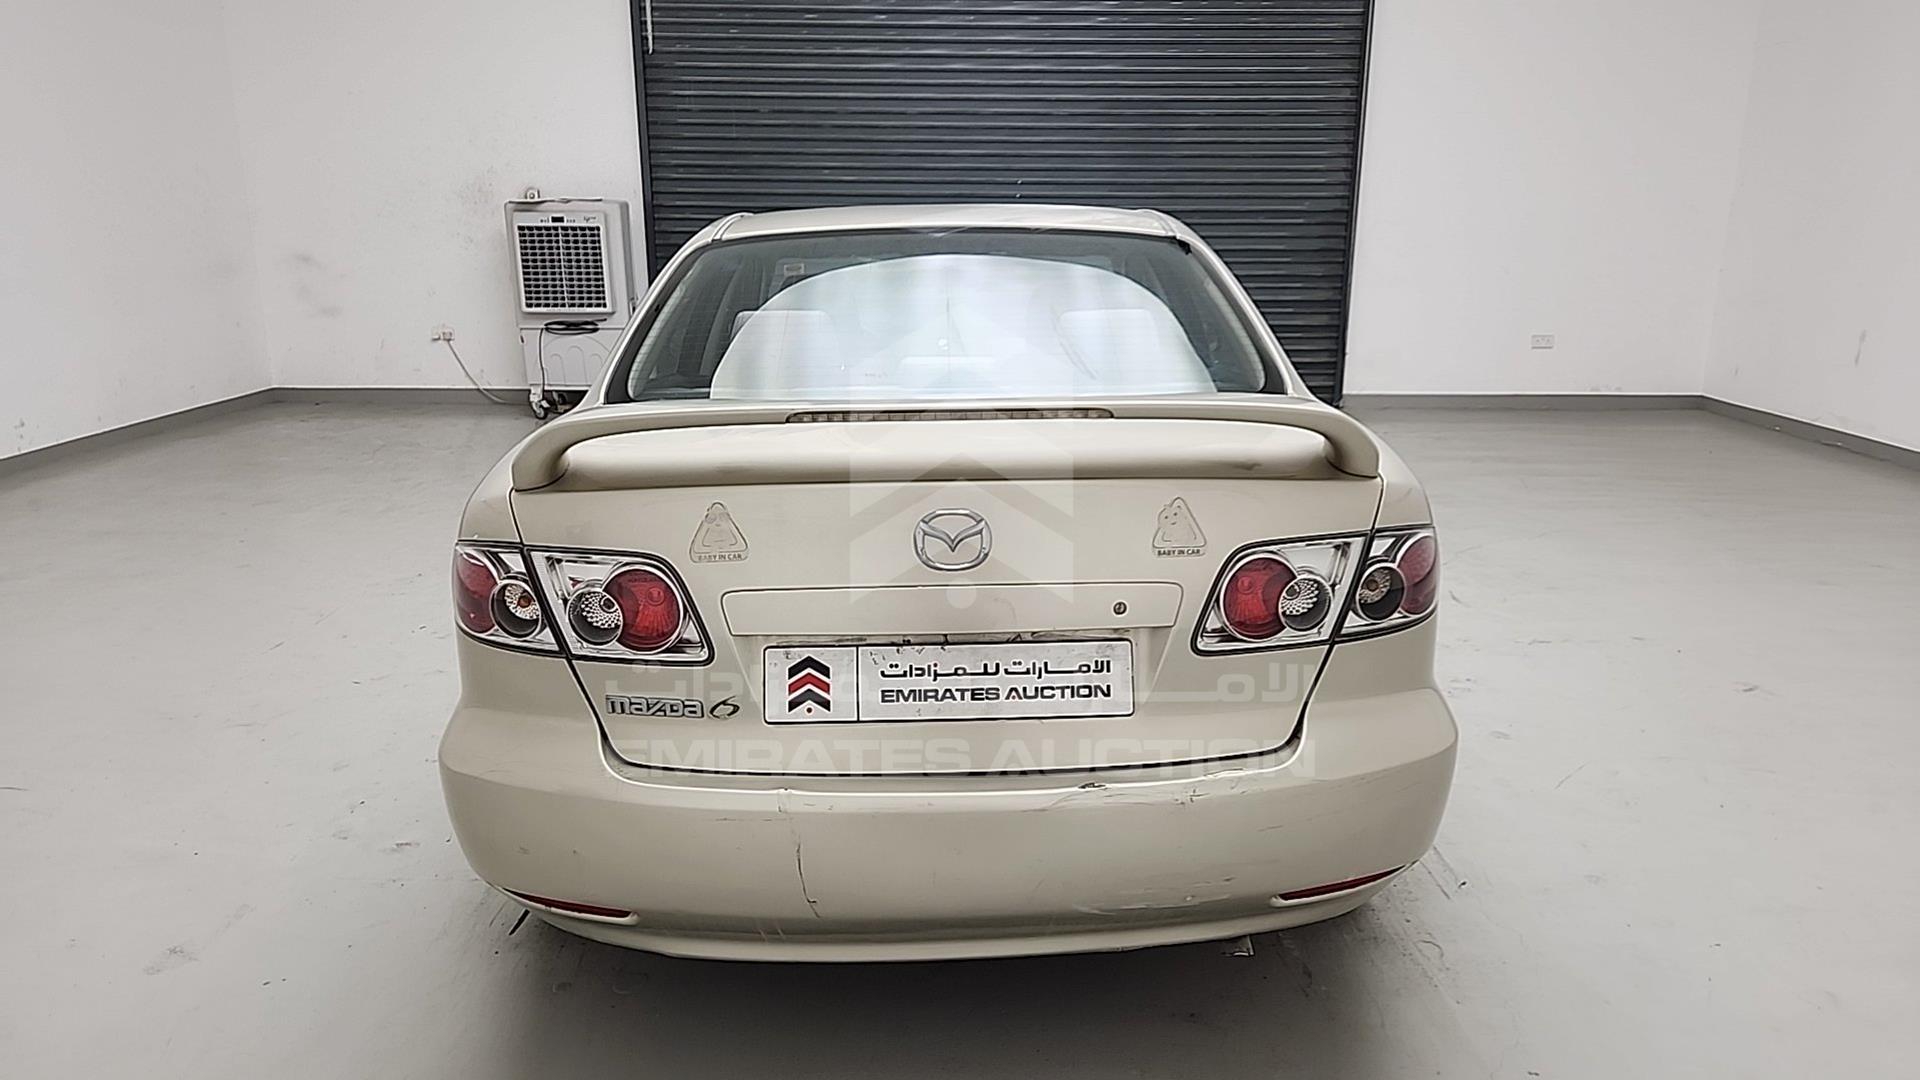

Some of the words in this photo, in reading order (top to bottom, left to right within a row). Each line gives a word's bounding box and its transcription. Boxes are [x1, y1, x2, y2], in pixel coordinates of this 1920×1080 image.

[727, 553, 742, 561] CAR
[880, 662, 1000, 681] للمزادات
[880, 687, 1000, 703] EMIRATES
[1004, 684, 1111, 700] AUCTION
[709, 696, 741, 719] 6
